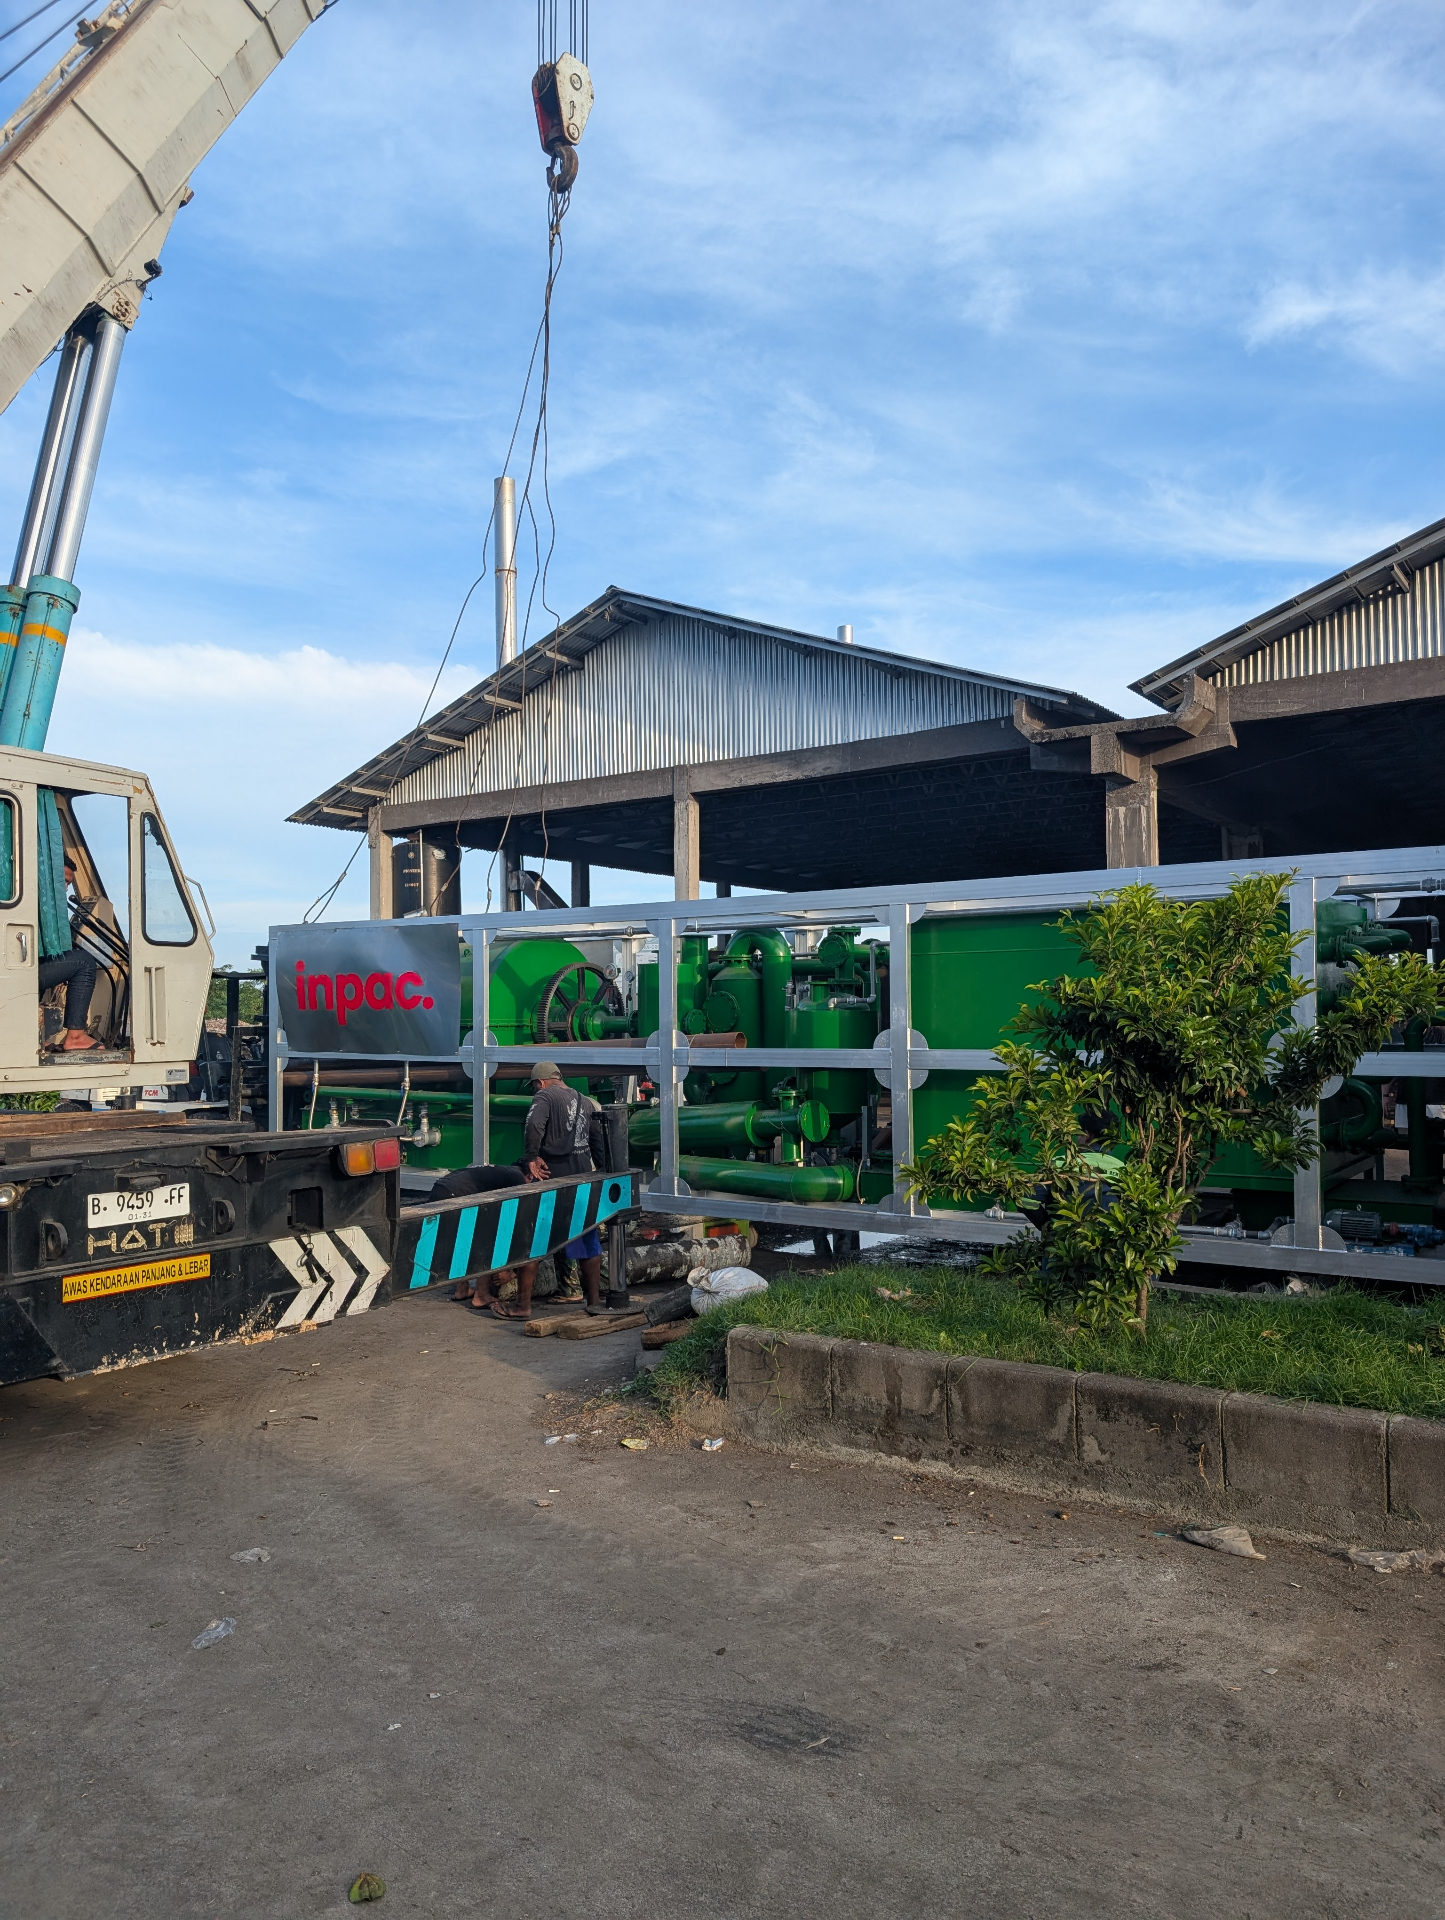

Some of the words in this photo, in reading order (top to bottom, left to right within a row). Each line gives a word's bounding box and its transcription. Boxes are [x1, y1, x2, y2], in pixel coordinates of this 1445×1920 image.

[295, 960, 435, 1026] inpac.
[117, 1190, 154, 1212] 9459
[63, 1279, 88, 1298] AWAS
[89, 1273, 140, 1293] KENDARAAN
[141, 1264, 176, 1284] PANJANG
[177, 1262, 183, 1277] &
[184, 1258, 209, 1276] LEBAR
